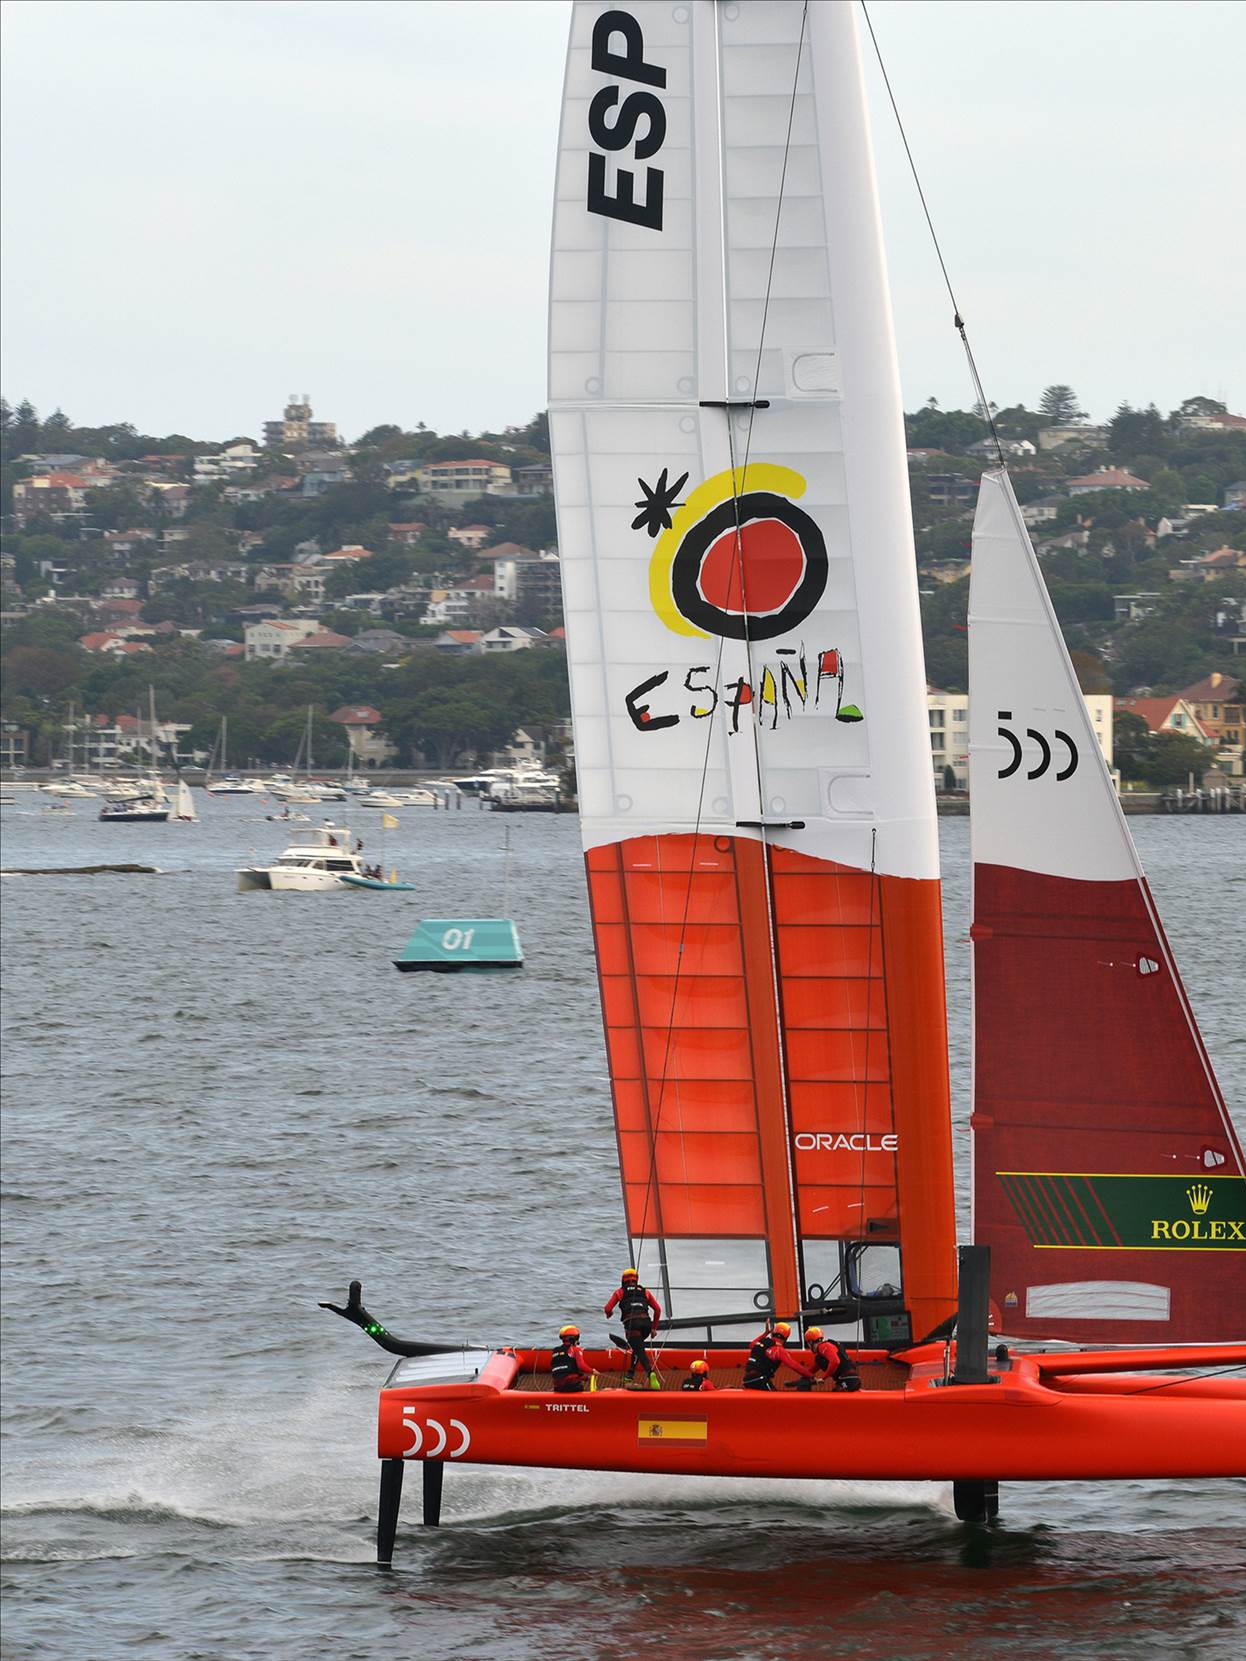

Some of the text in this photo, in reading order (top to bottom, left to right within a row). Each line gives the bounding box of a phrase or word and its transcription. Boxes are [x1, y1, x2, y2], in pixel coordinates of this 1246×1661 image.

[587, 10, 667, 231] ESP
[625, 640, 864, 736] ESPAÑA
[441, 928, 475, 950] 01
[794, 1133, 899, 1151] ORACLE
[1150, 1219, 1246, 1241] ROLEX
[545, 1403, 590, 1412] TRITTEL
